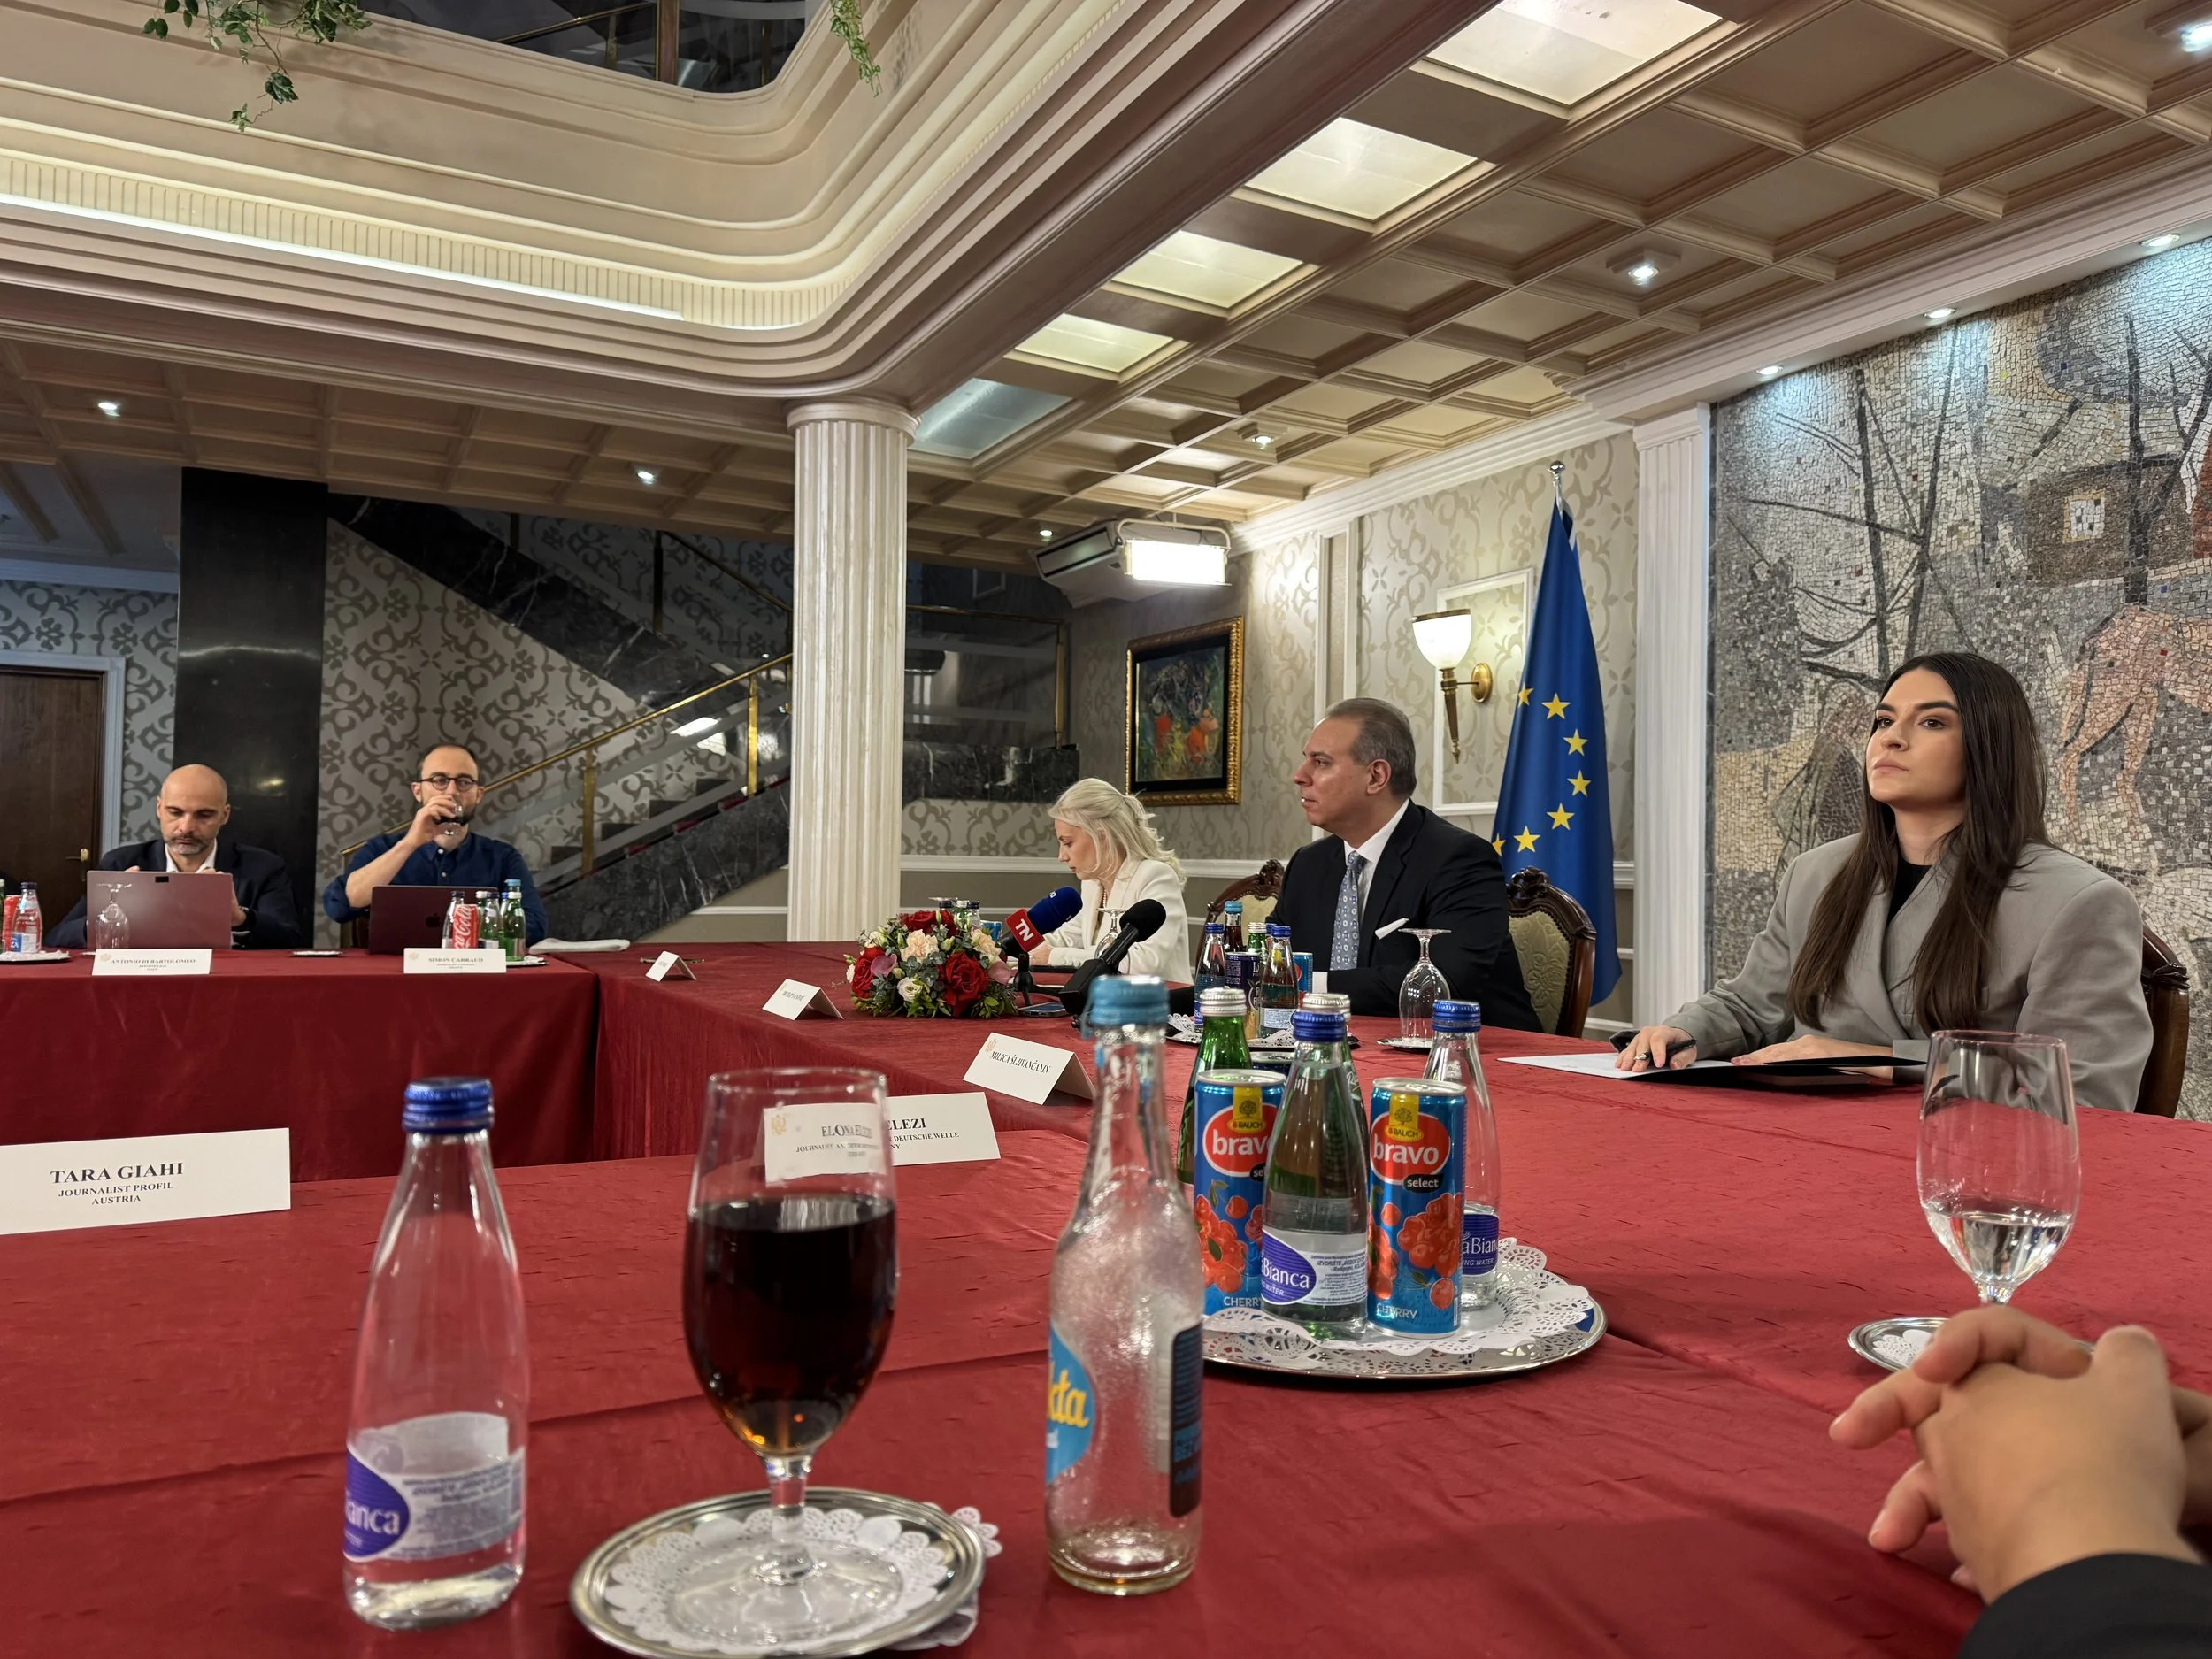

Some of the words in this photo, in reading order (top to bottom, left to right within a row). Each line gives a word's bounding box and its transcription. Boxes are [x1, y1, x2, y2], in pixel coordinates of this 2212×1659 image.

[991, 1051, 1010, 1064] MILICA
[894, 1133, 933, 1142] DEUTSCHE
[933, 1132, 959, 1141] WELLE
[1394, 1128, 1418, 1138] RAUCH
[1373, 1133, 1440, 1165] bravo
[50, 1167, 111, 1184] TARA
[117, 1162, 184, 1179] GIAHI
[1407, 1177, 1439, 1187] select
[58, 1185, 131, 1197] JOURNALIST
[134, 1181, 174, 1192] PROFIL
[91, 1194, 142, 1205] AUSTRIA
[1376, 1302, 1417, 1319] CHERRY
